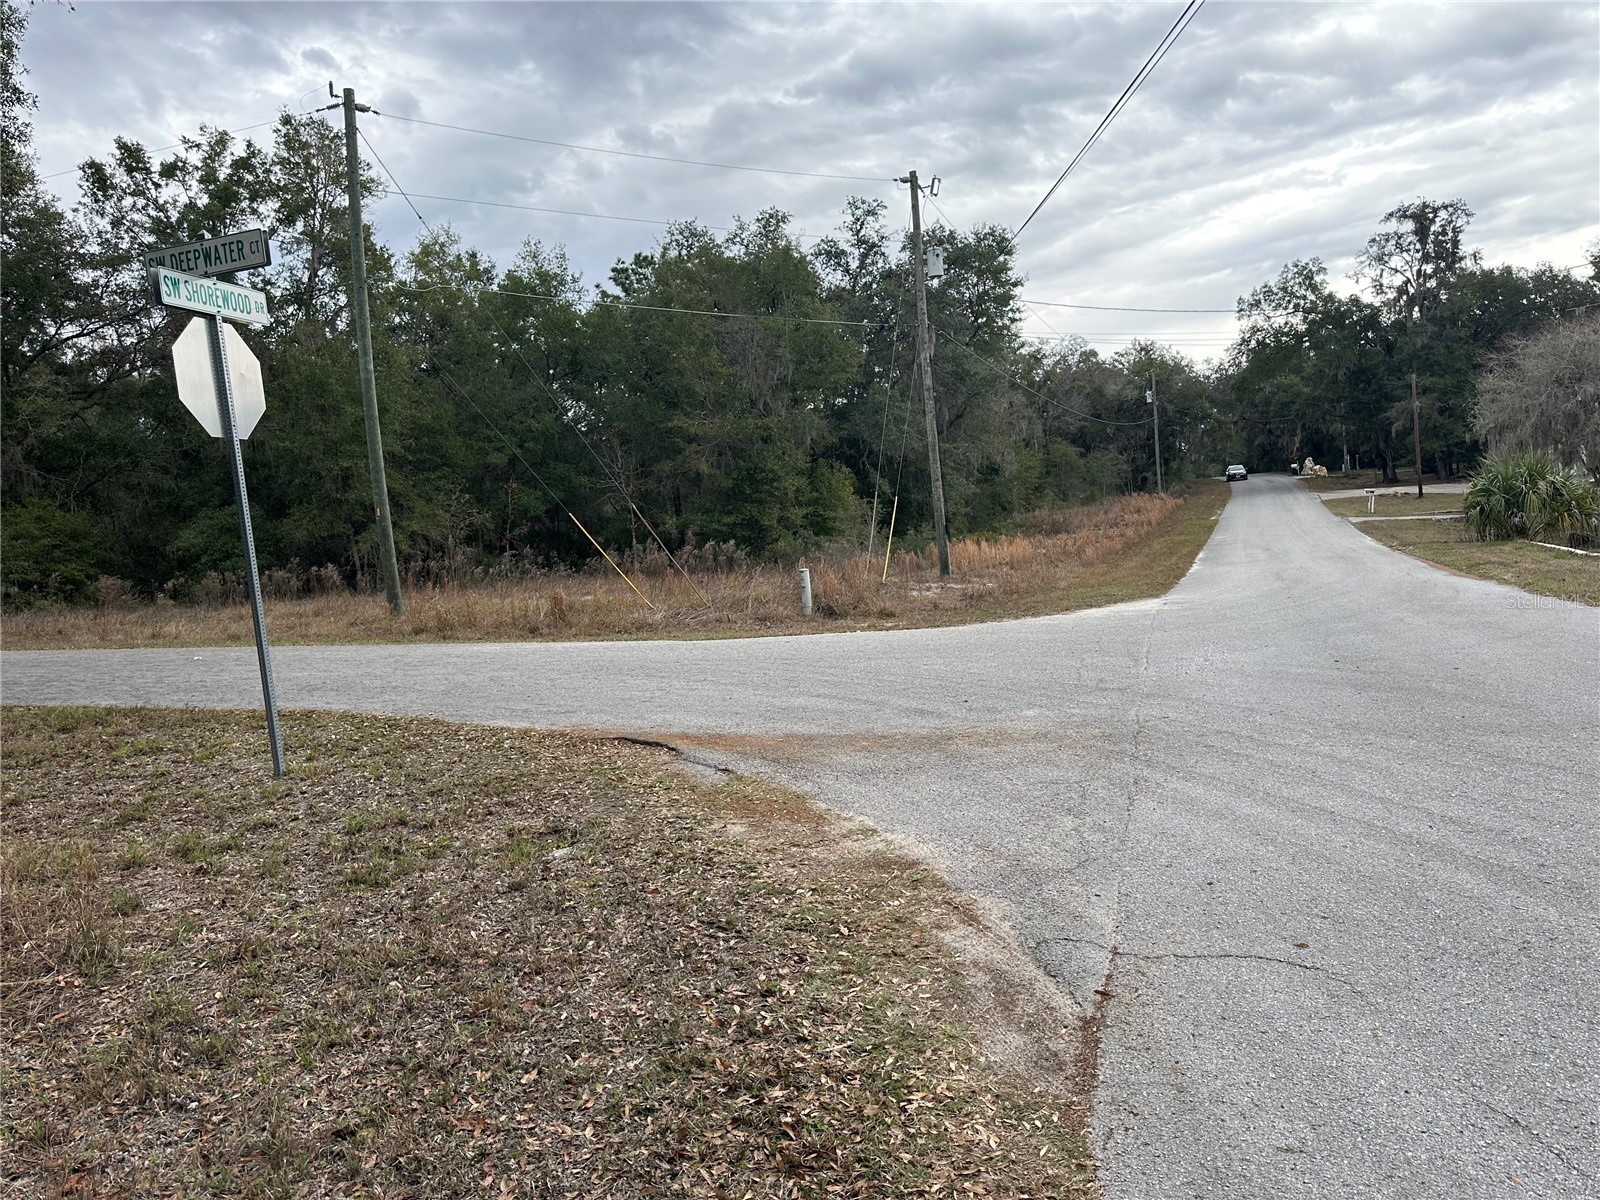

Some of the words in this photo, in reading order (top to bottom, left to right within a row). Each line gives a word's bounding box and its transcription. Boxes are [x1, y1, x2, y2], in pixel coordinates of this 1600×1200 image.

[170, 240, 246, 272] DEEPWATER
[249, 240, 260, 255] CT
[163, 274, 181, 299] SW
[184, 280, 252, 315] SHOREWOOD
[254, 300, 266, 315] DR
